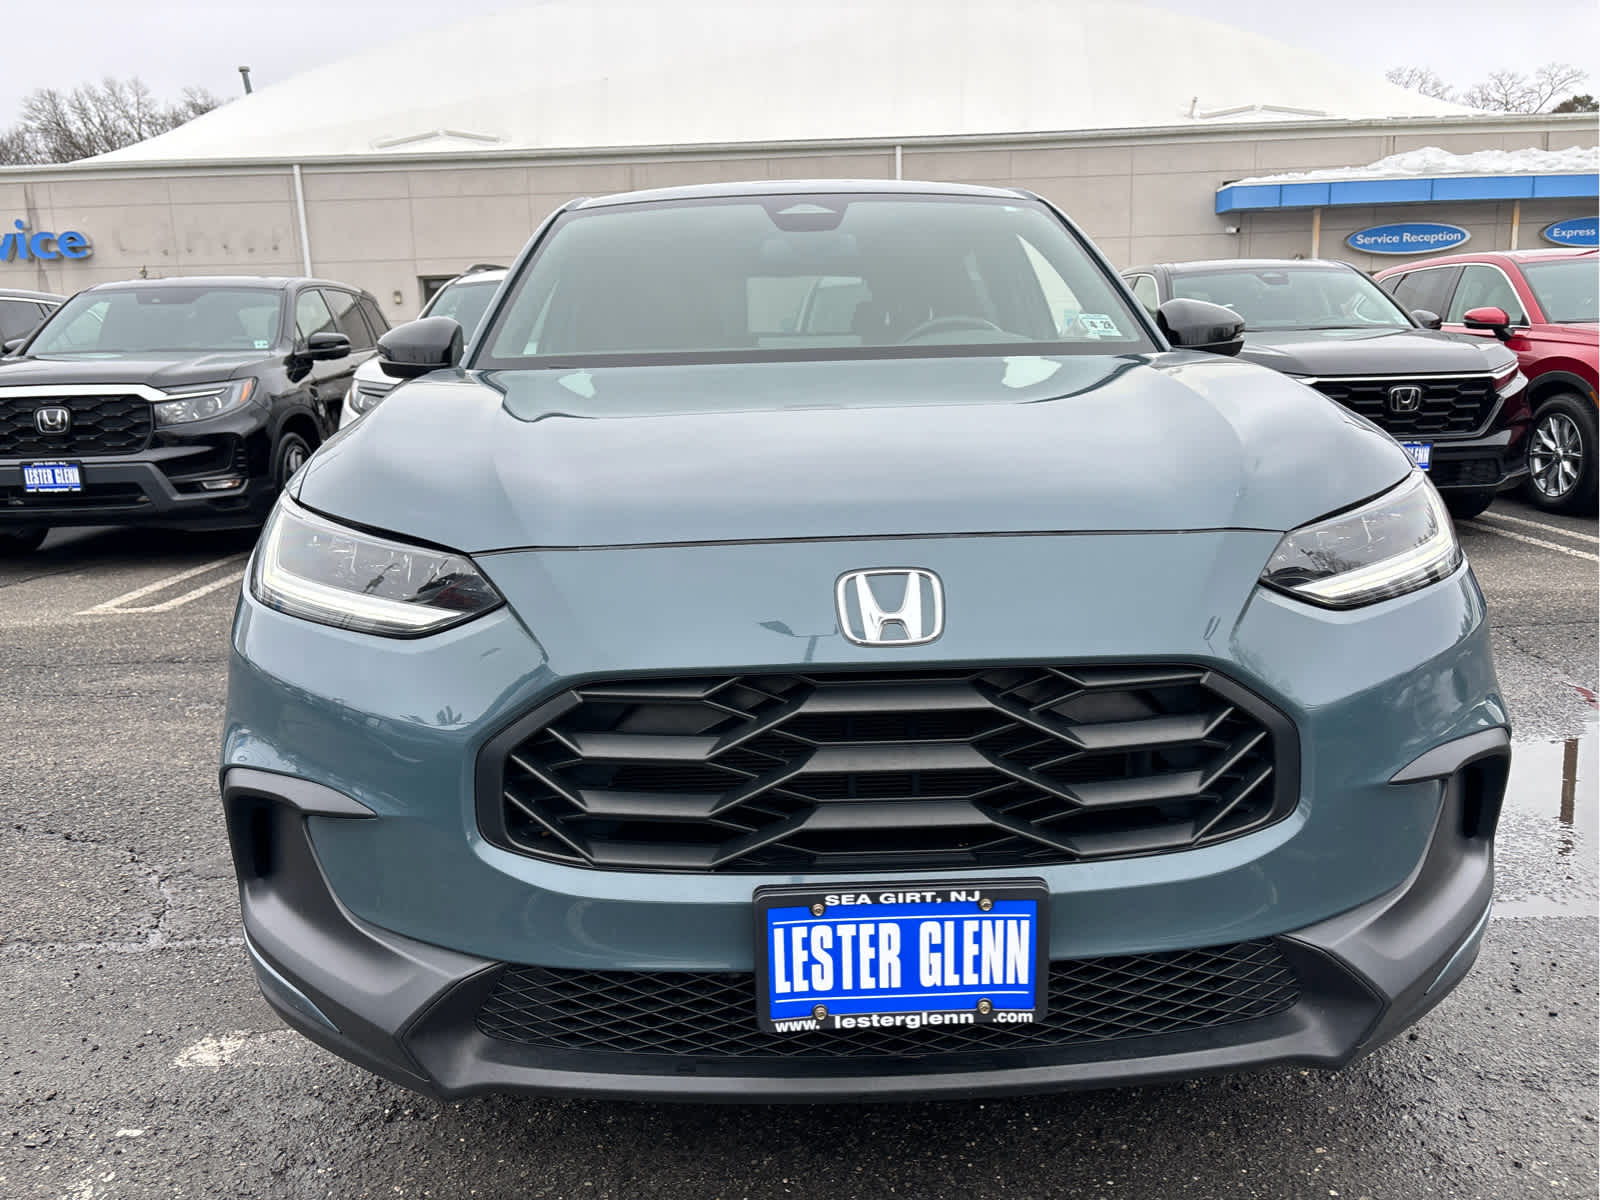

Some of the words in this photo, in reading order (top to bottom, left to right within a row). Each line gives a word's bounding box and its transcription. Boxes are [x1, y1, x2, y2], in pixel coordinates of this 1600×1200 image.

[1355, 233, 1400, 245] Service
[1402, 231, 1462, 245] Reception
[1553, 227, 1596, 240] Express
[24, 468, 54, 485] LESTER
[54, 467, 81, 484] GLENN
[824, 893, 873, 906] SEA
[879, 891, 942, 904] GIRT,
[950, 890, 981, 902] NJ
[772, 922, 902, 994] LESTER
[918, 919, 1031, 988] GLENN
[774, 1020, 821, 1033] www.
[834, 1012, 975, 1030] lesterglenn
[992, 1011, 1033, 1024] .com
